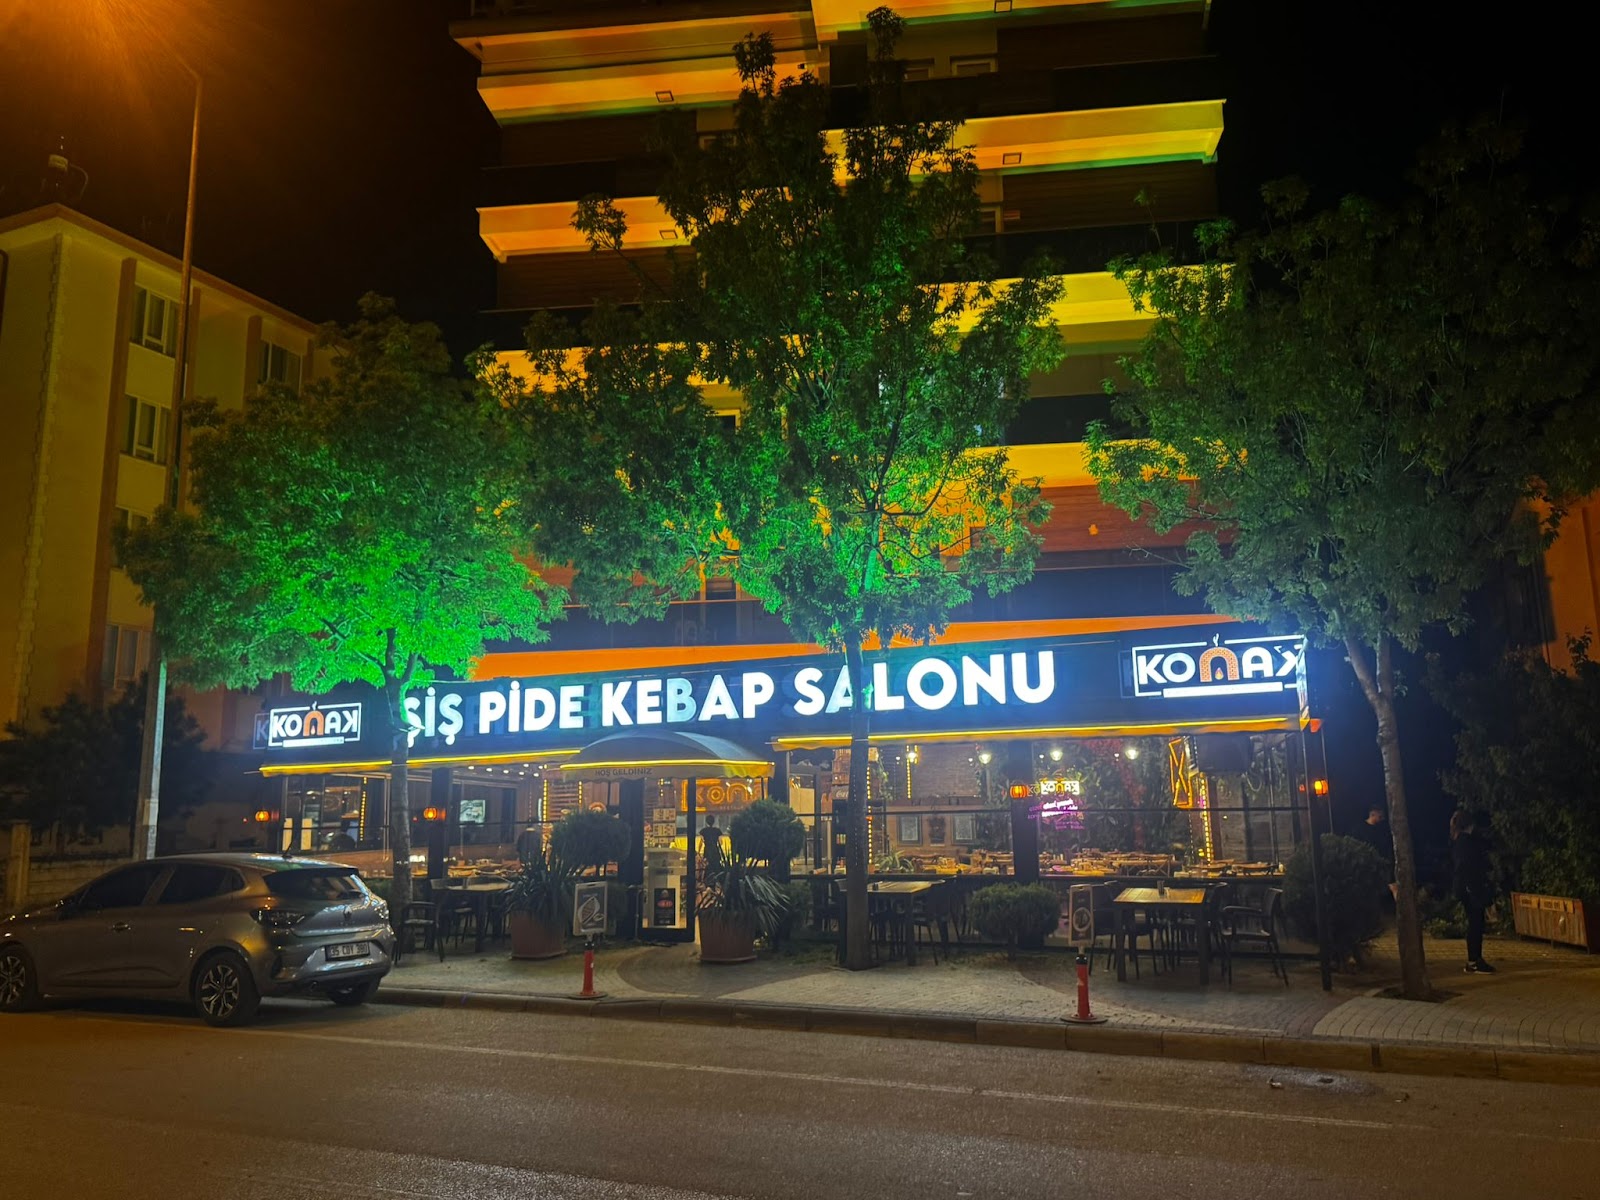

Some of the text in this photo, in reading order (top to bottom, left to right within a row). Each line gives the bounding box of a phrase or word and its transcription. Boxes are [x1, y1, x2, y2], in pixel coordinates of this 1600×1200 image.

[479, 680, 585, 734] PİDE
[601, 671, 775, 727] KEBAP
[793, 650, 1056, 716] SALONU
[272, 710, 358, 738] KONAK
[595, 767, 652, 777] HOŞ GELDİNİZ
